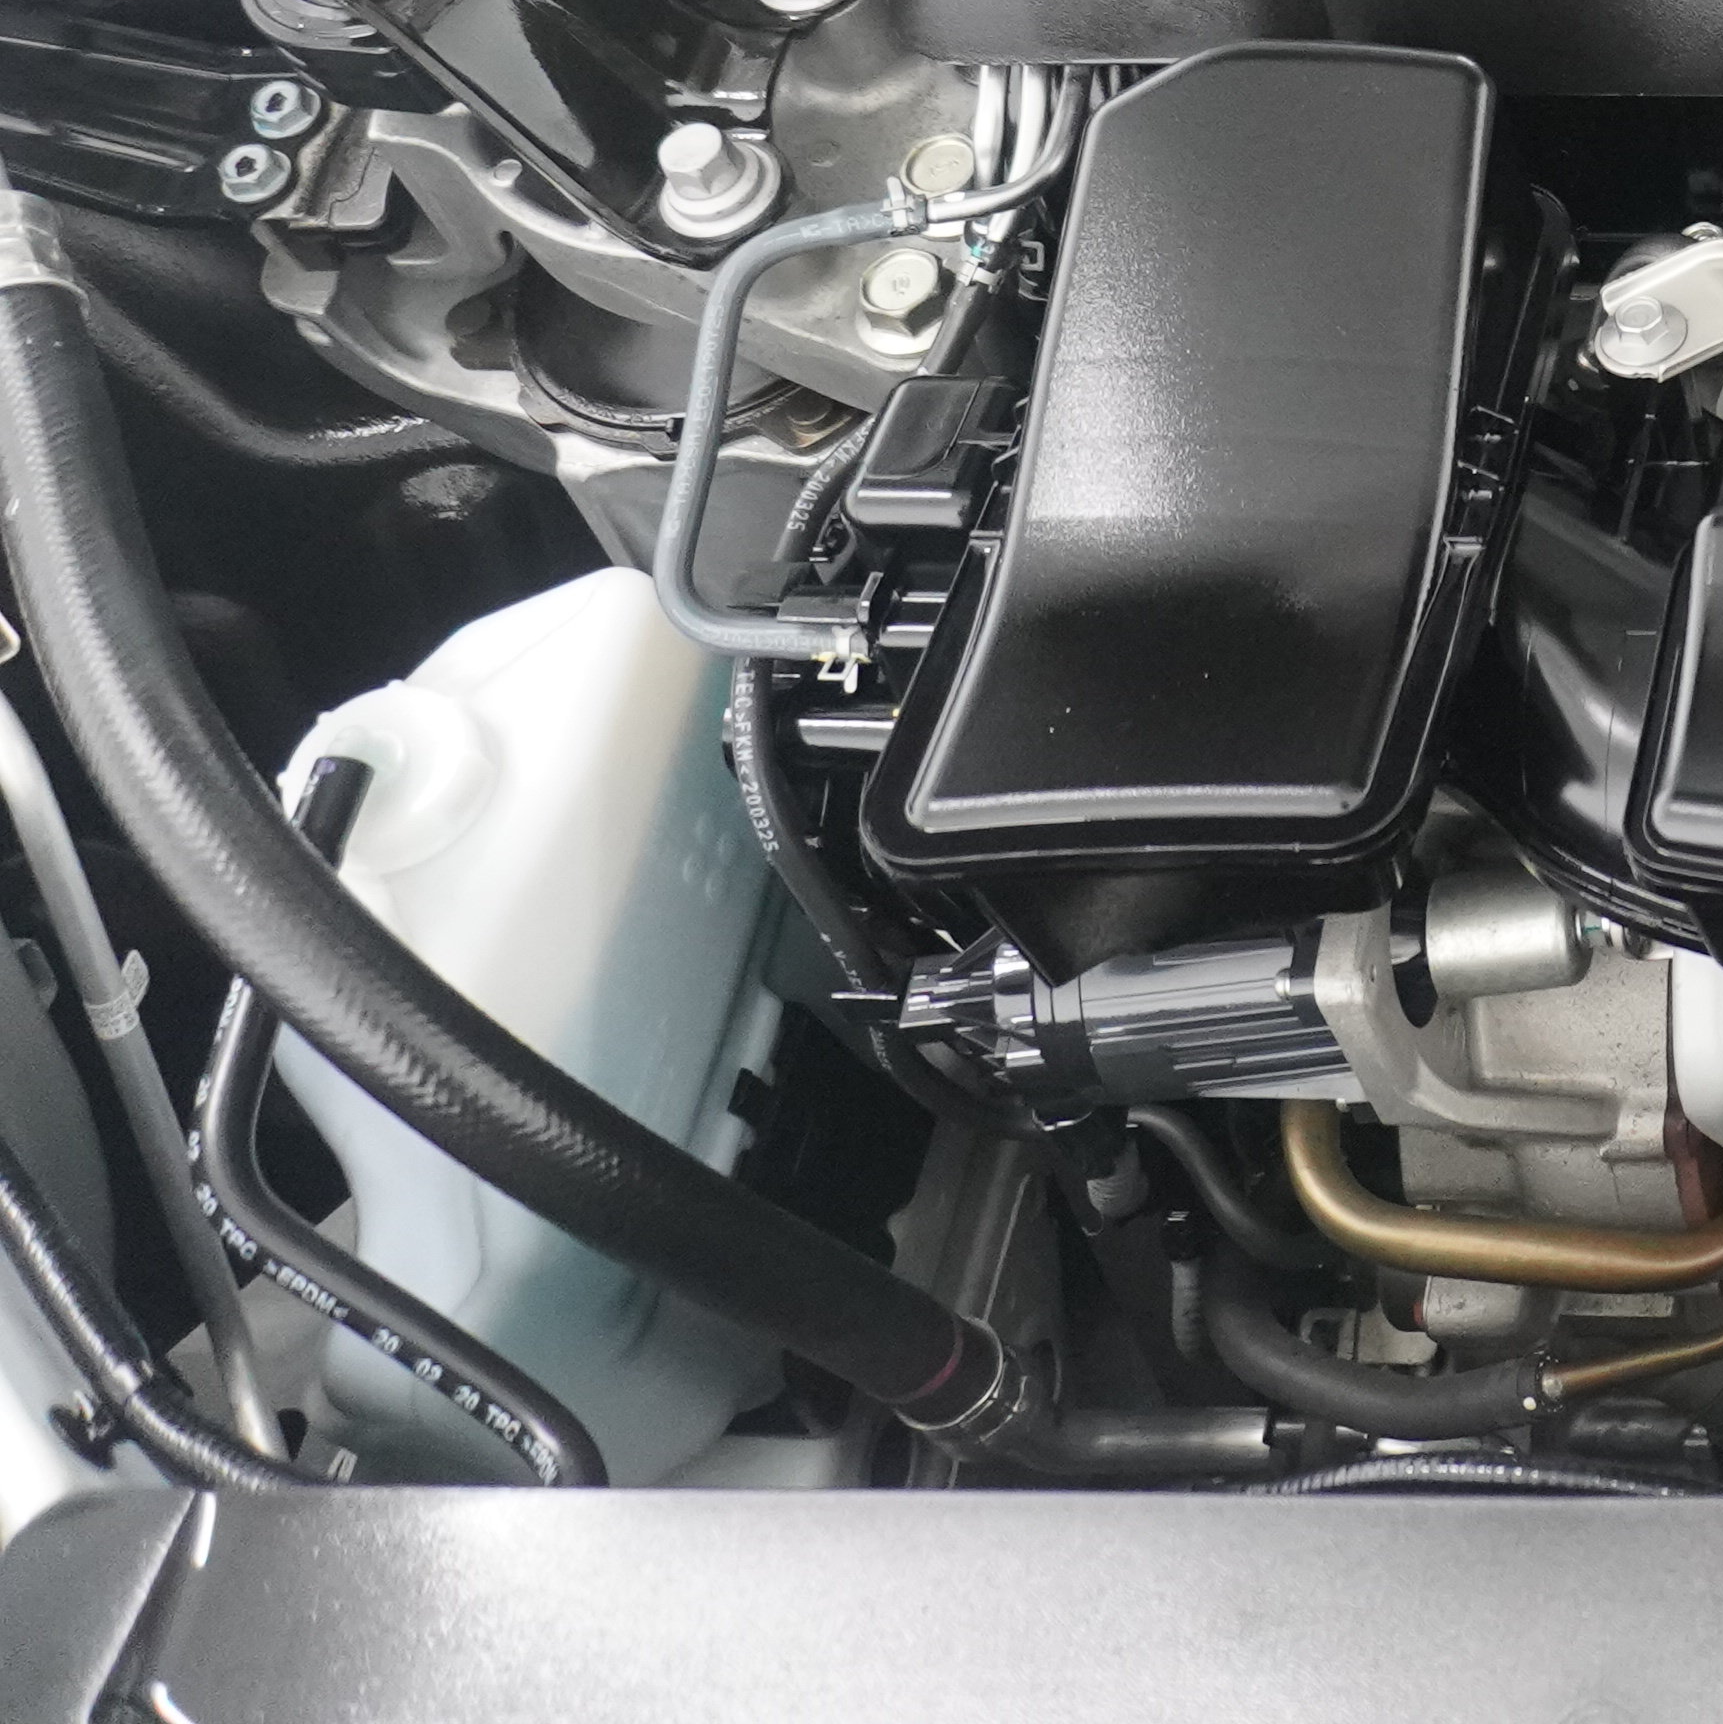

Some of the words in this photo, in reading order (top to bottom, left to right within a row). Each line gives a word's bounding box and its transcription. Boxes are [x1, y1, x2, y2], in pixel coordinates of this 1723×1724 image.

[787, 469, 831, 532] 200325
[742, 781, 780, 854] 200325
[371, 1326, 402, 1355] 20
[452, 1384, 482, 1411] 20
